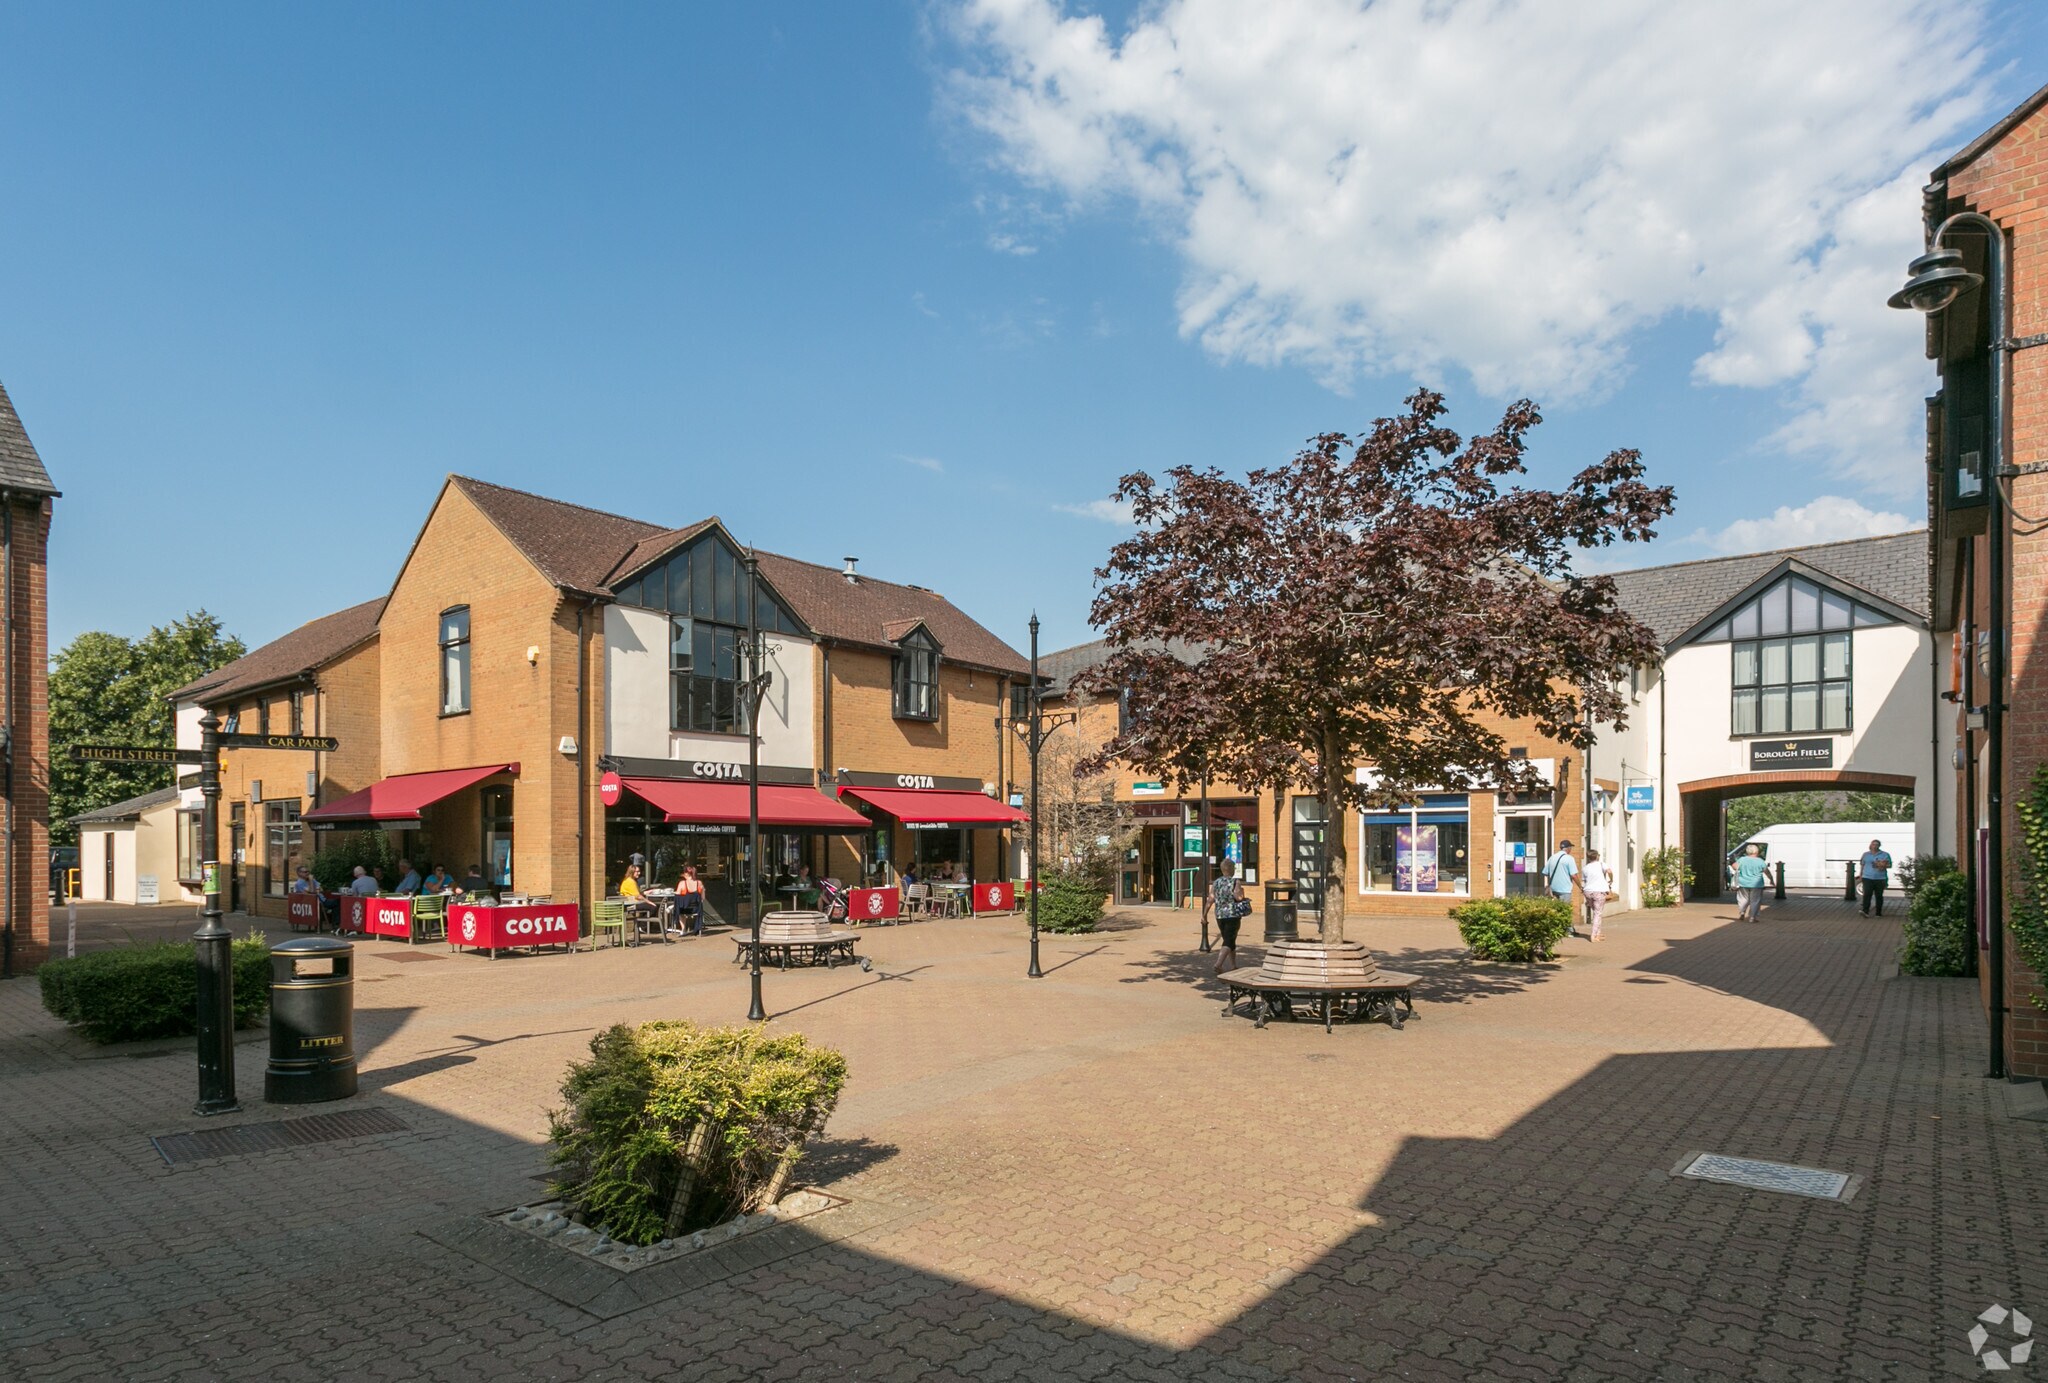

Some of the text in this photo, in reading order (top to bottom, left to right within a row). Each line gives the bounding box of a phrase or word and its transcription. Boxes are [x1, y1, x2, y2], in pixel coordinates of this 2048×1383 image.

[267, 737, 329, 749] CAR PARK
[81, 748, 178, 762] HIGH STREET
[1754, 748, 1830, 759] BOROUGH FIELDS
[693, 762, 743, 779] COSTA
[601, 784, 618, 793] COSTA
[897, 774, 935, 789] COSTA
[291, 903, 313, 917] COSTA
[379, 909, 406, 926] COSTA
[505, 916, 568, 935] COSTA
[300, 1035, 344, 1048] LITTER
